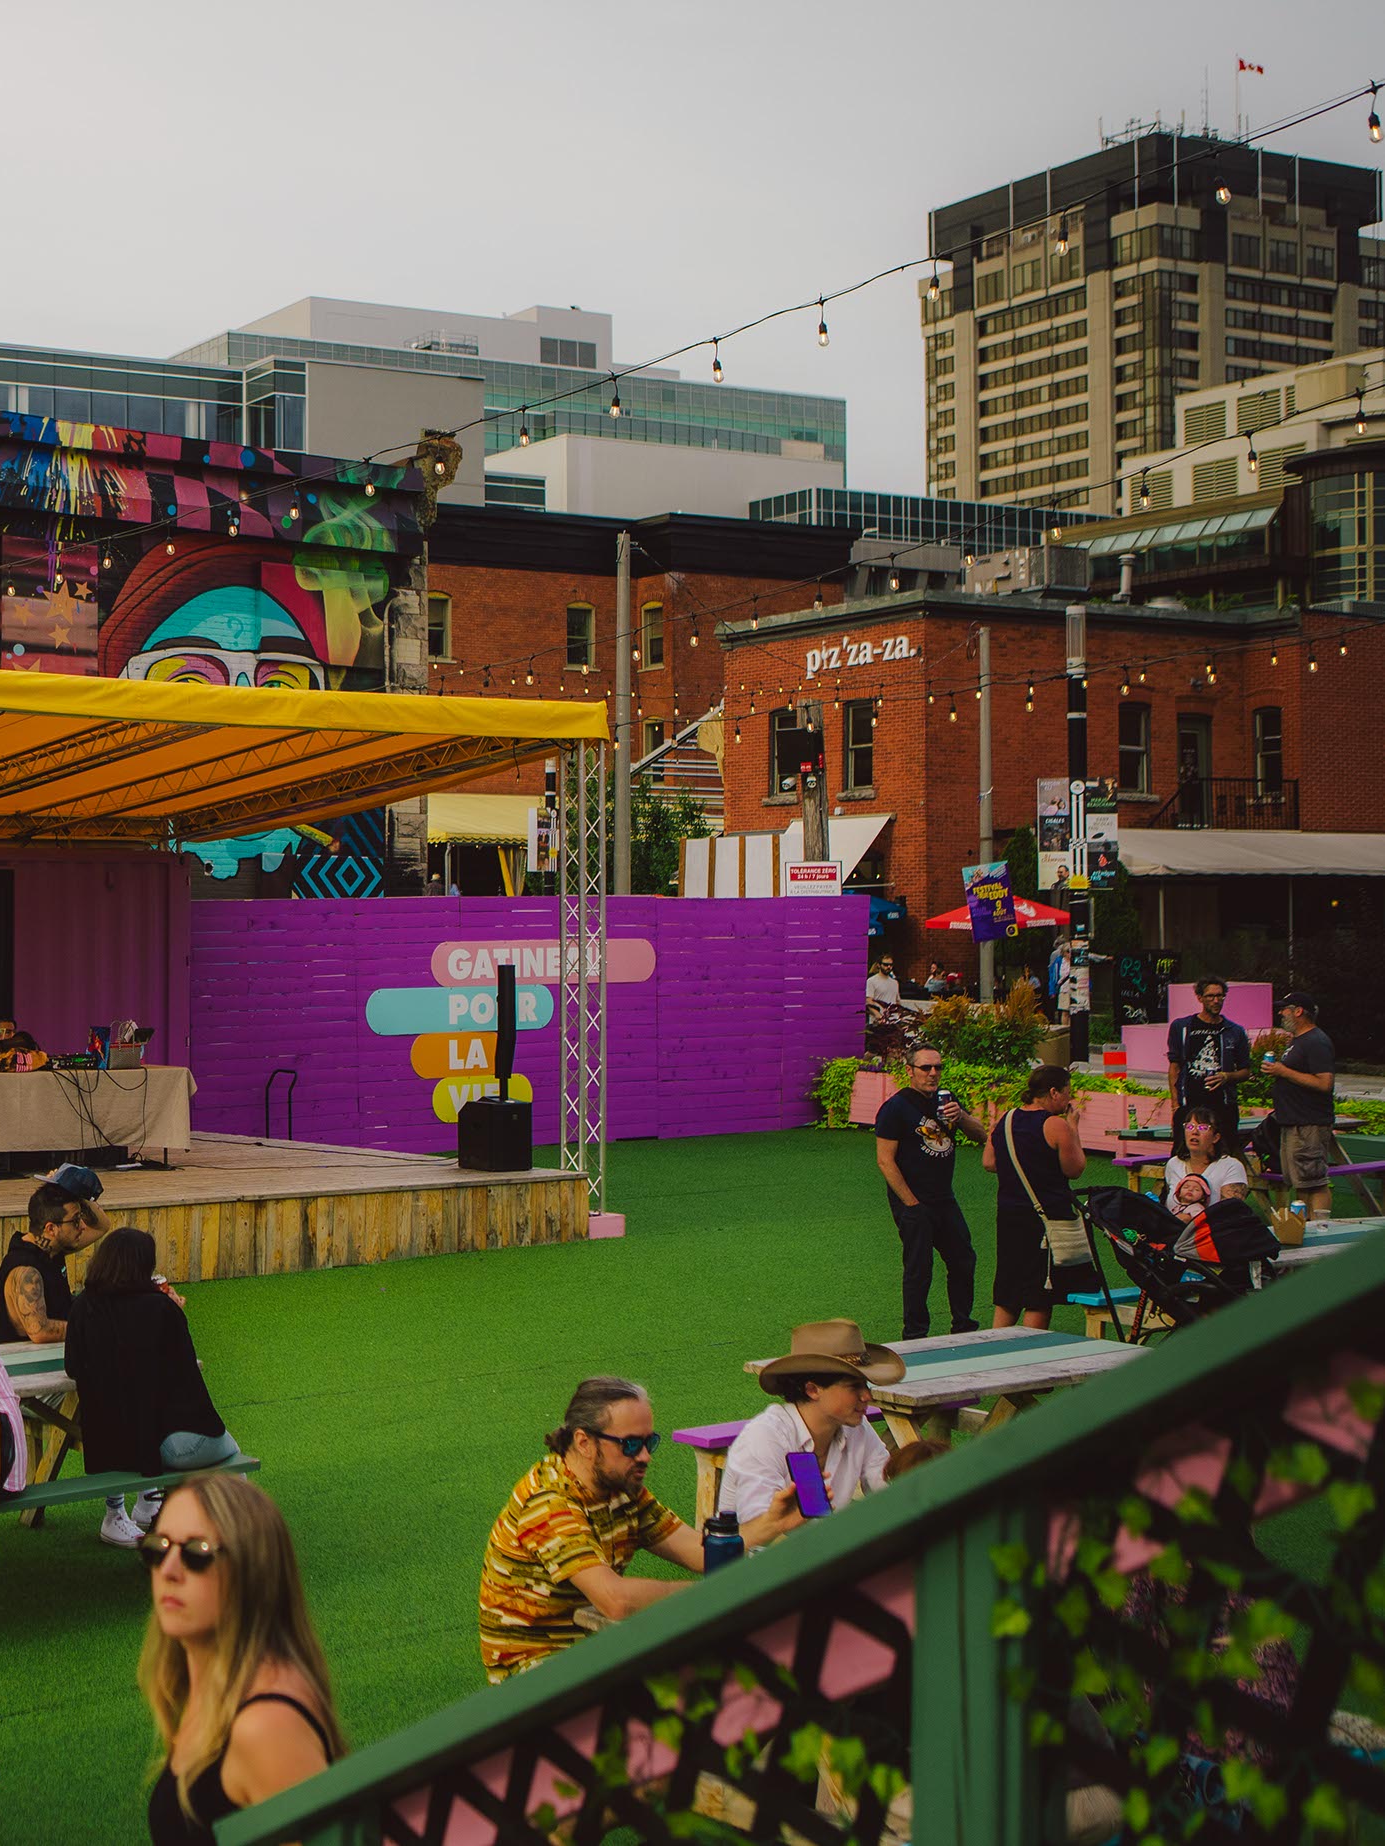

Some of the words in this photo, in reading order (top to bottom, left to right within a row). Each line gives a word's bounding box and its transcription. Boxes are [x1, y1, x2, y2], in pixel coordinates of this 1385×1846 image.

[972, 882, 1004, 896] FESTIVAL
[995, 899, 1002, 911] 9
[448, 992, 537, 1025] POR
[448, 1039, 488, 1070] LA
